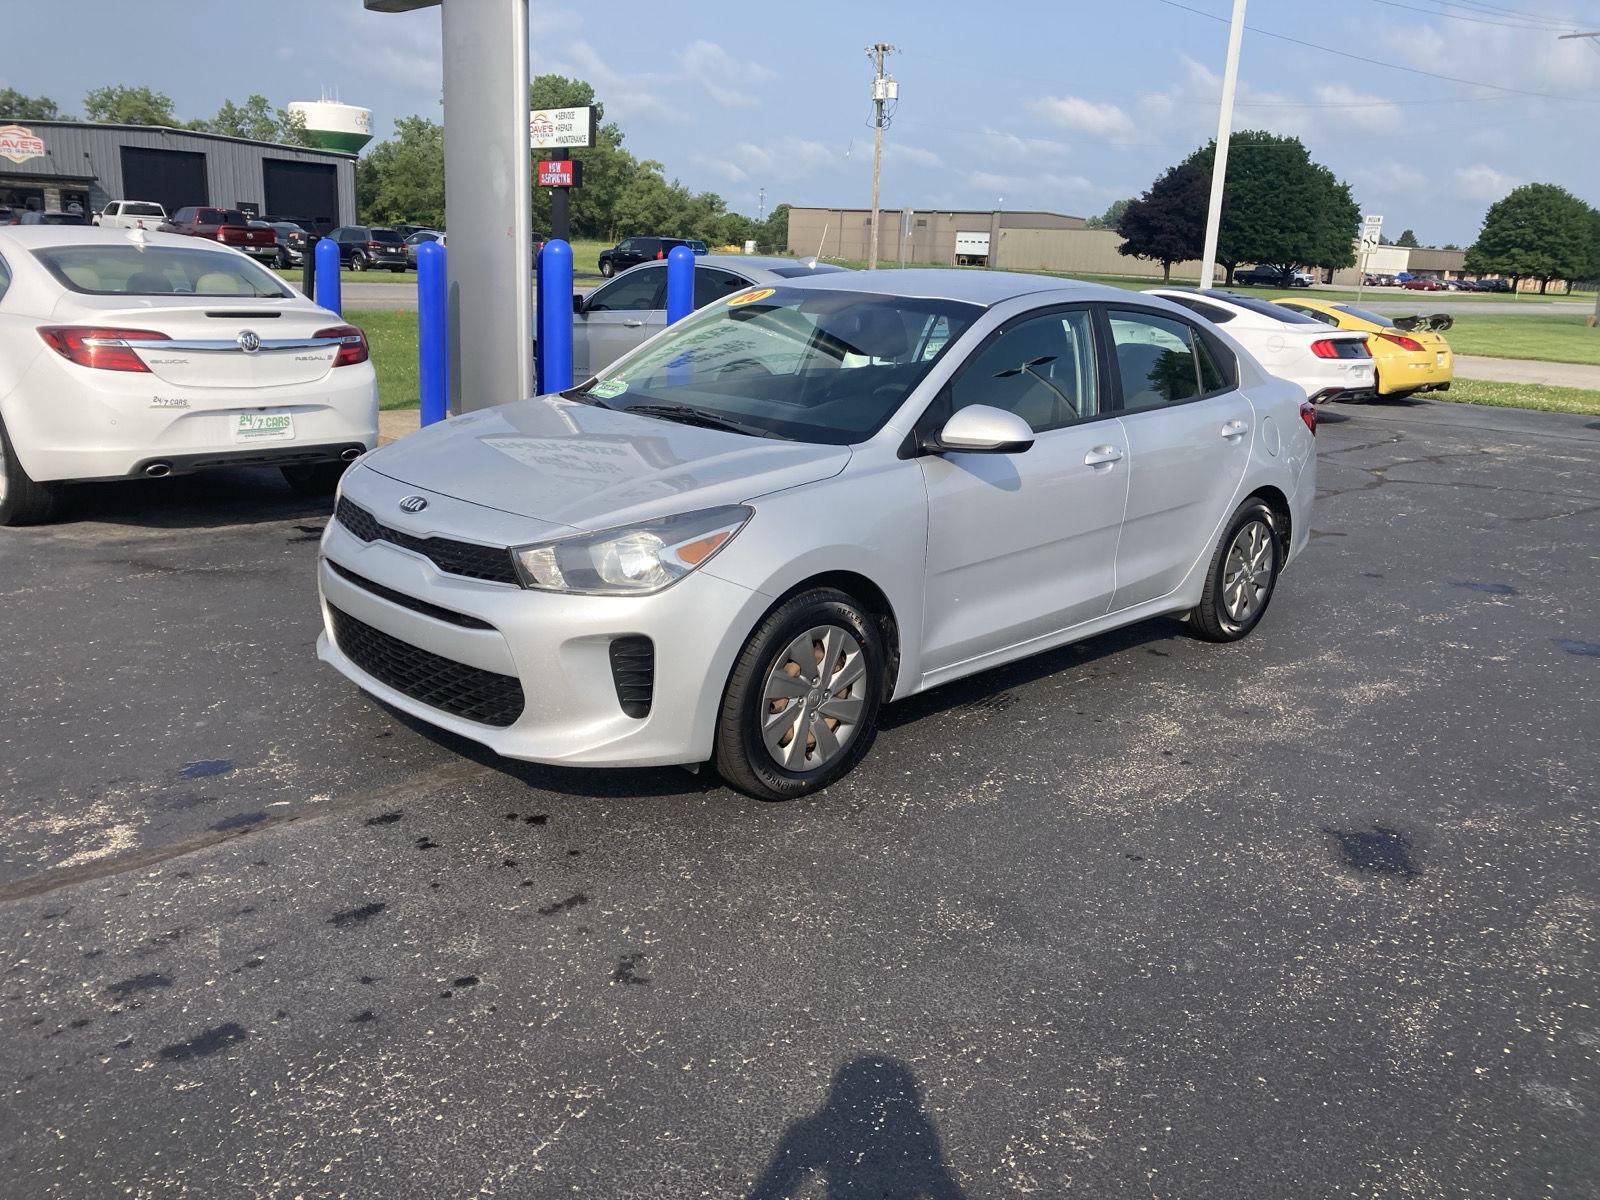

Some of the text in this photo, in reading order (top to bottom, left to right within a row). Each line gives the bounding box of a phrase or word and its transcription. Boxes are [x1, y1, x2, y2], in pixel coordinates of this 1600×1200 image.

[1, 140, 42, 149] AVE'S
[169, 398, 188, 406] CARS
[239, 414, 290, 429] 24/7 CARS
